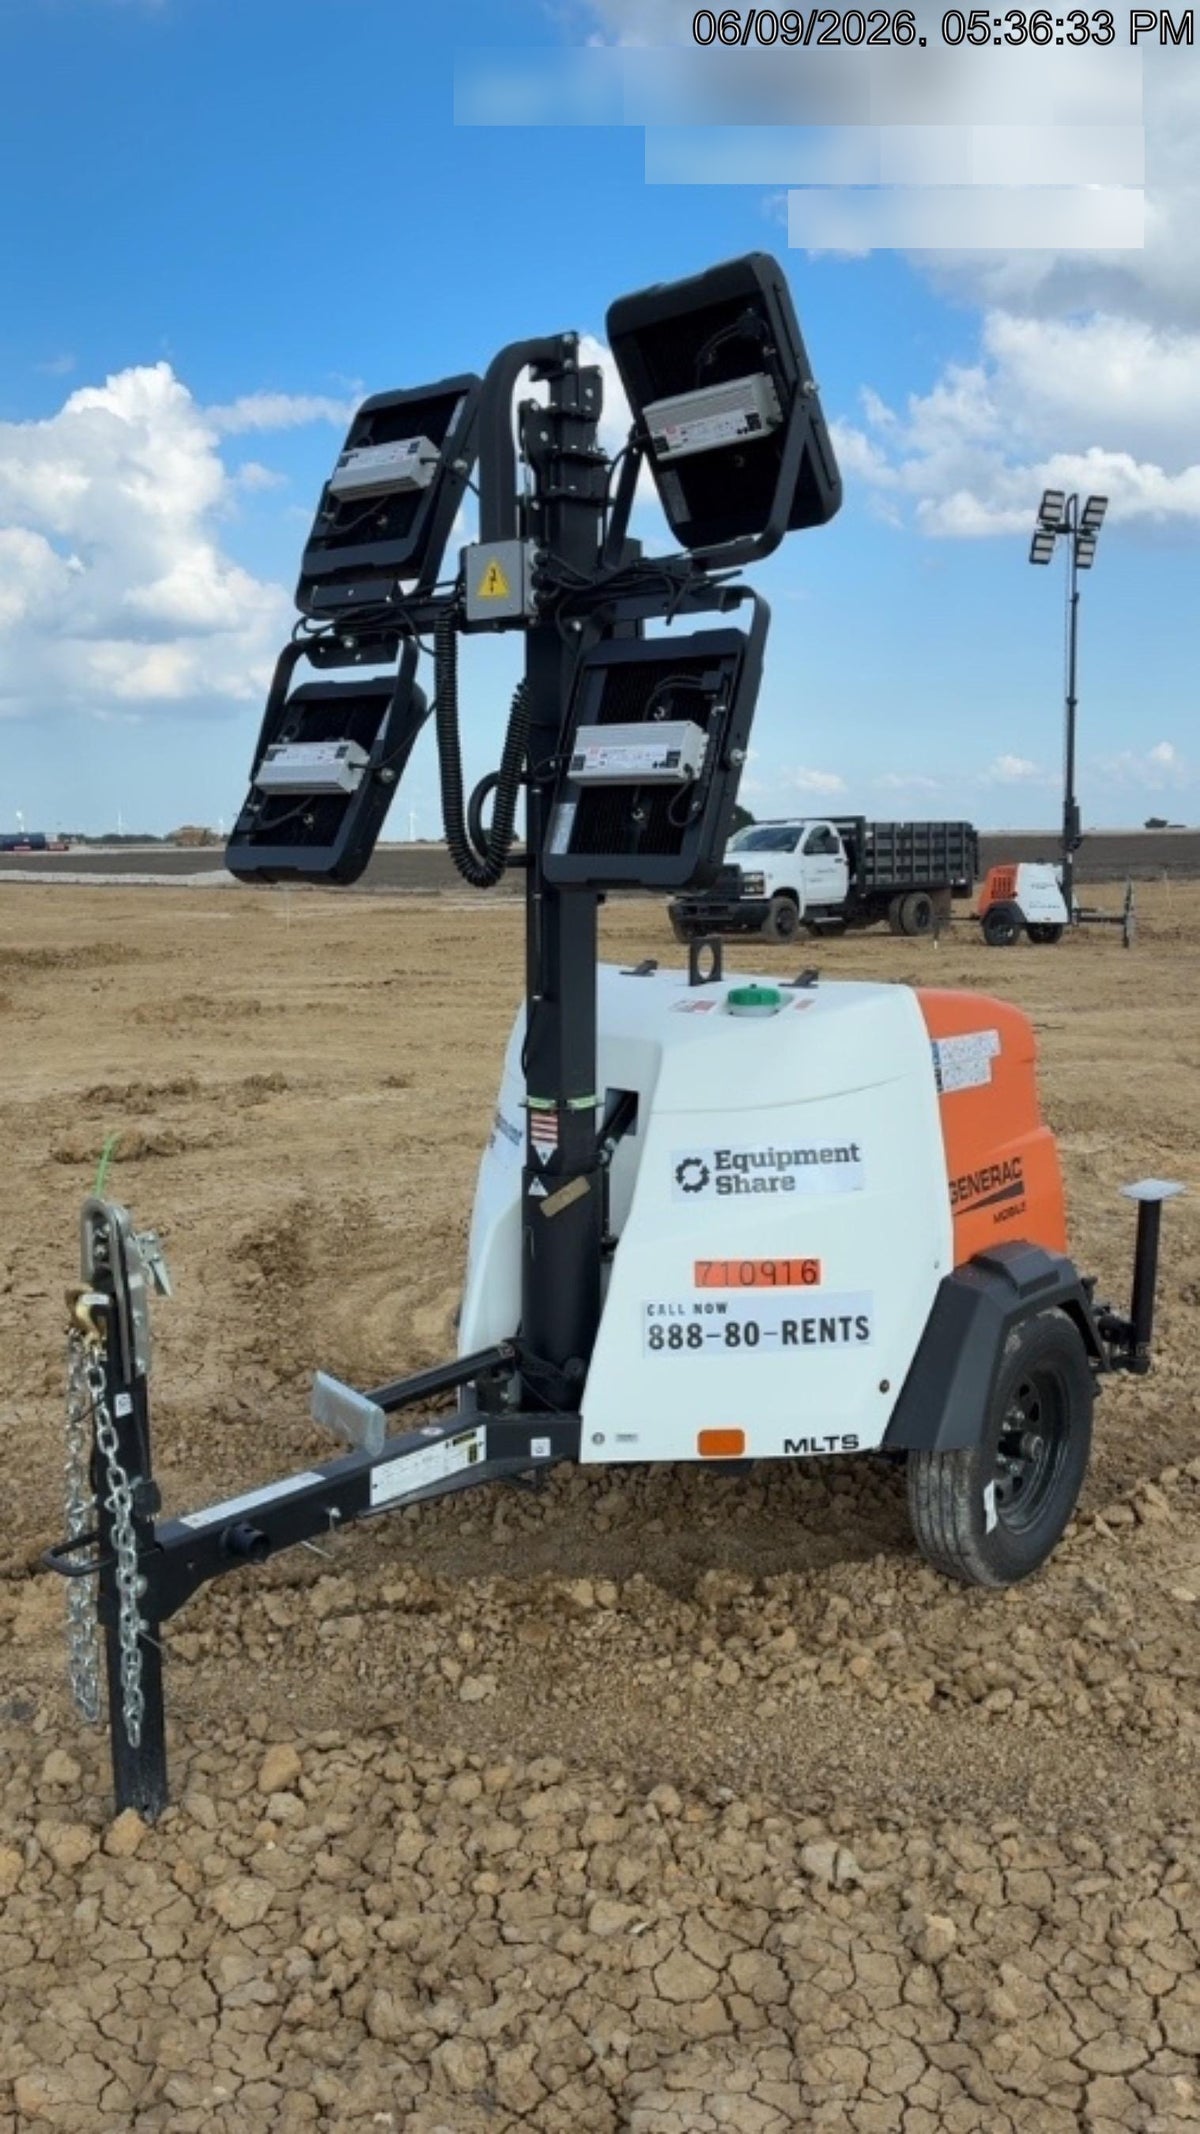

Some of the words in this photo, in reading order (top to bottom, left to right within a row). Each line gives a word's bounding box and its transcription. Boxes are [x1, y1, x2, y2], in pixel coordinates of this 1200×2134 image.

[714, 1143, 861, 1173] Equipment
[715, 1173, 796, 1195] Share
[949, 1157, 1023, 1205] GENERAC
[697, 1259, 818, 1286] 710916
[646, 1304, 686, 1316] CALL
[693, 1302, 728, 1315] NOW
[648, 1315, 871, 1351] 888-80-RENTS
[784, 1433, 859, 1454] MLTS
